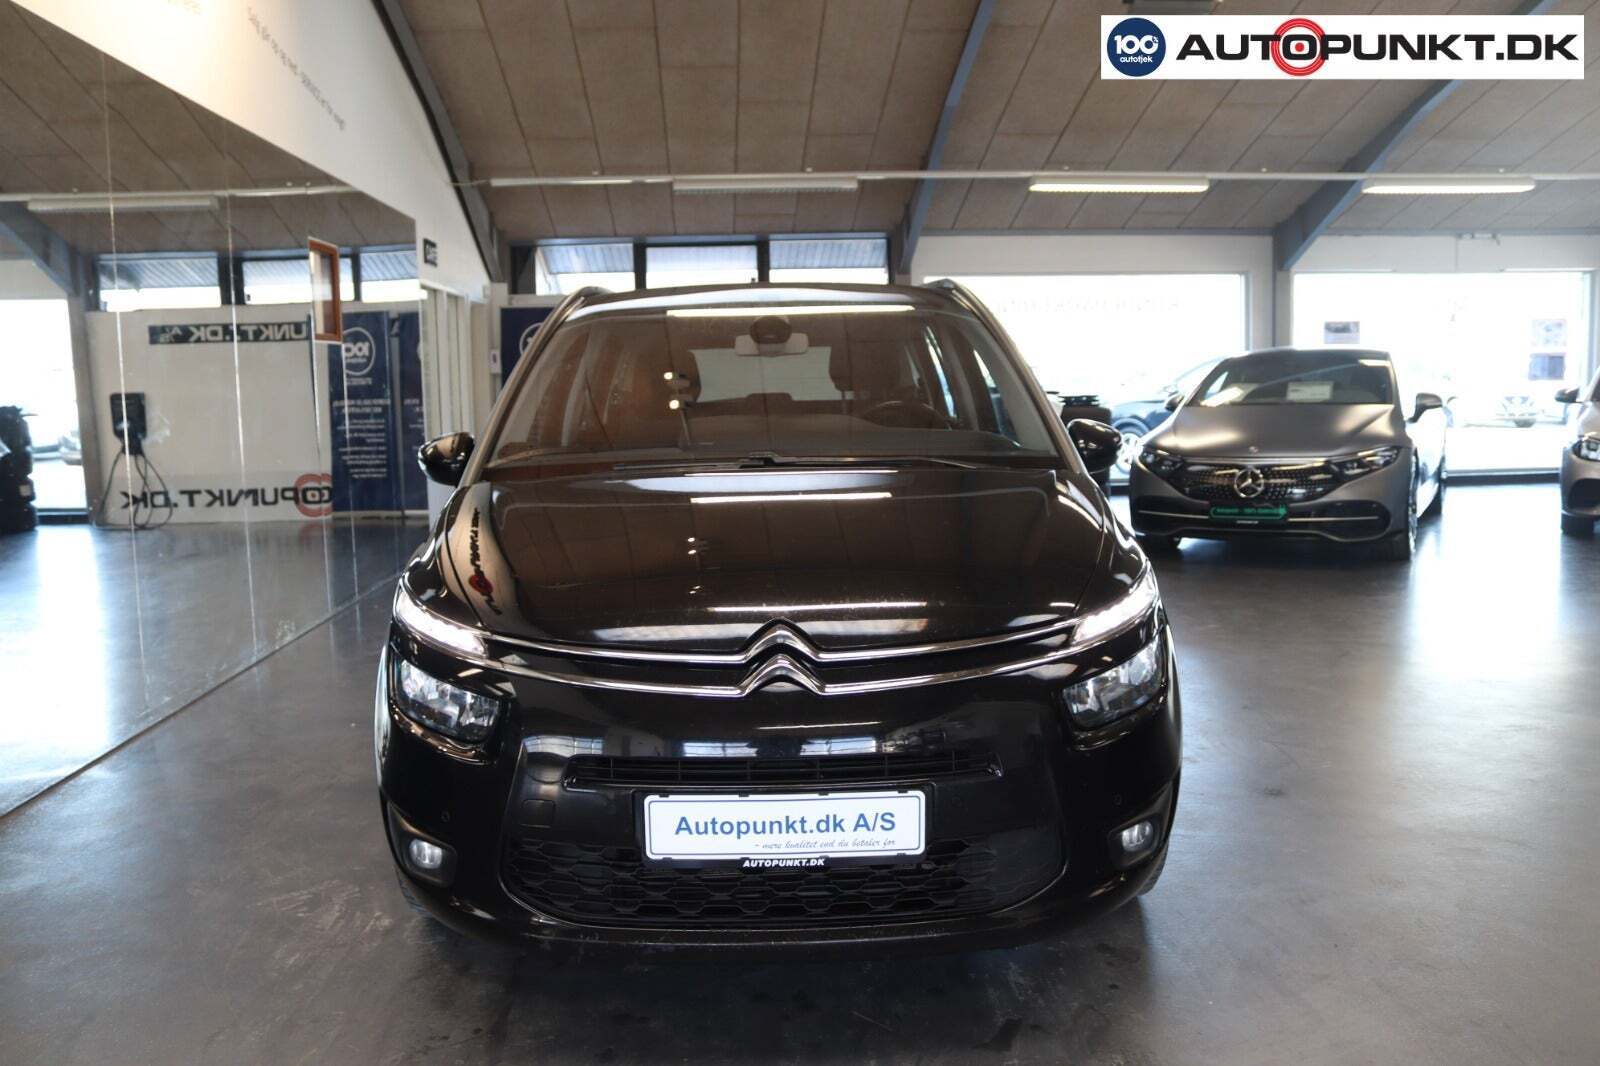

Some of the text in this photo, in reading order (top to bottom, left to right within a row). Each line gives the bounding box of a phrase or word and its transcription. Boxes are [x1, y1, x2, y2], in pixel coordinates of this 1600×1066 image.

[675, 811, 896, 840] Autopunkt.dk A/S
[743, 858, 825, 868] AUTOPUNKT.DK
